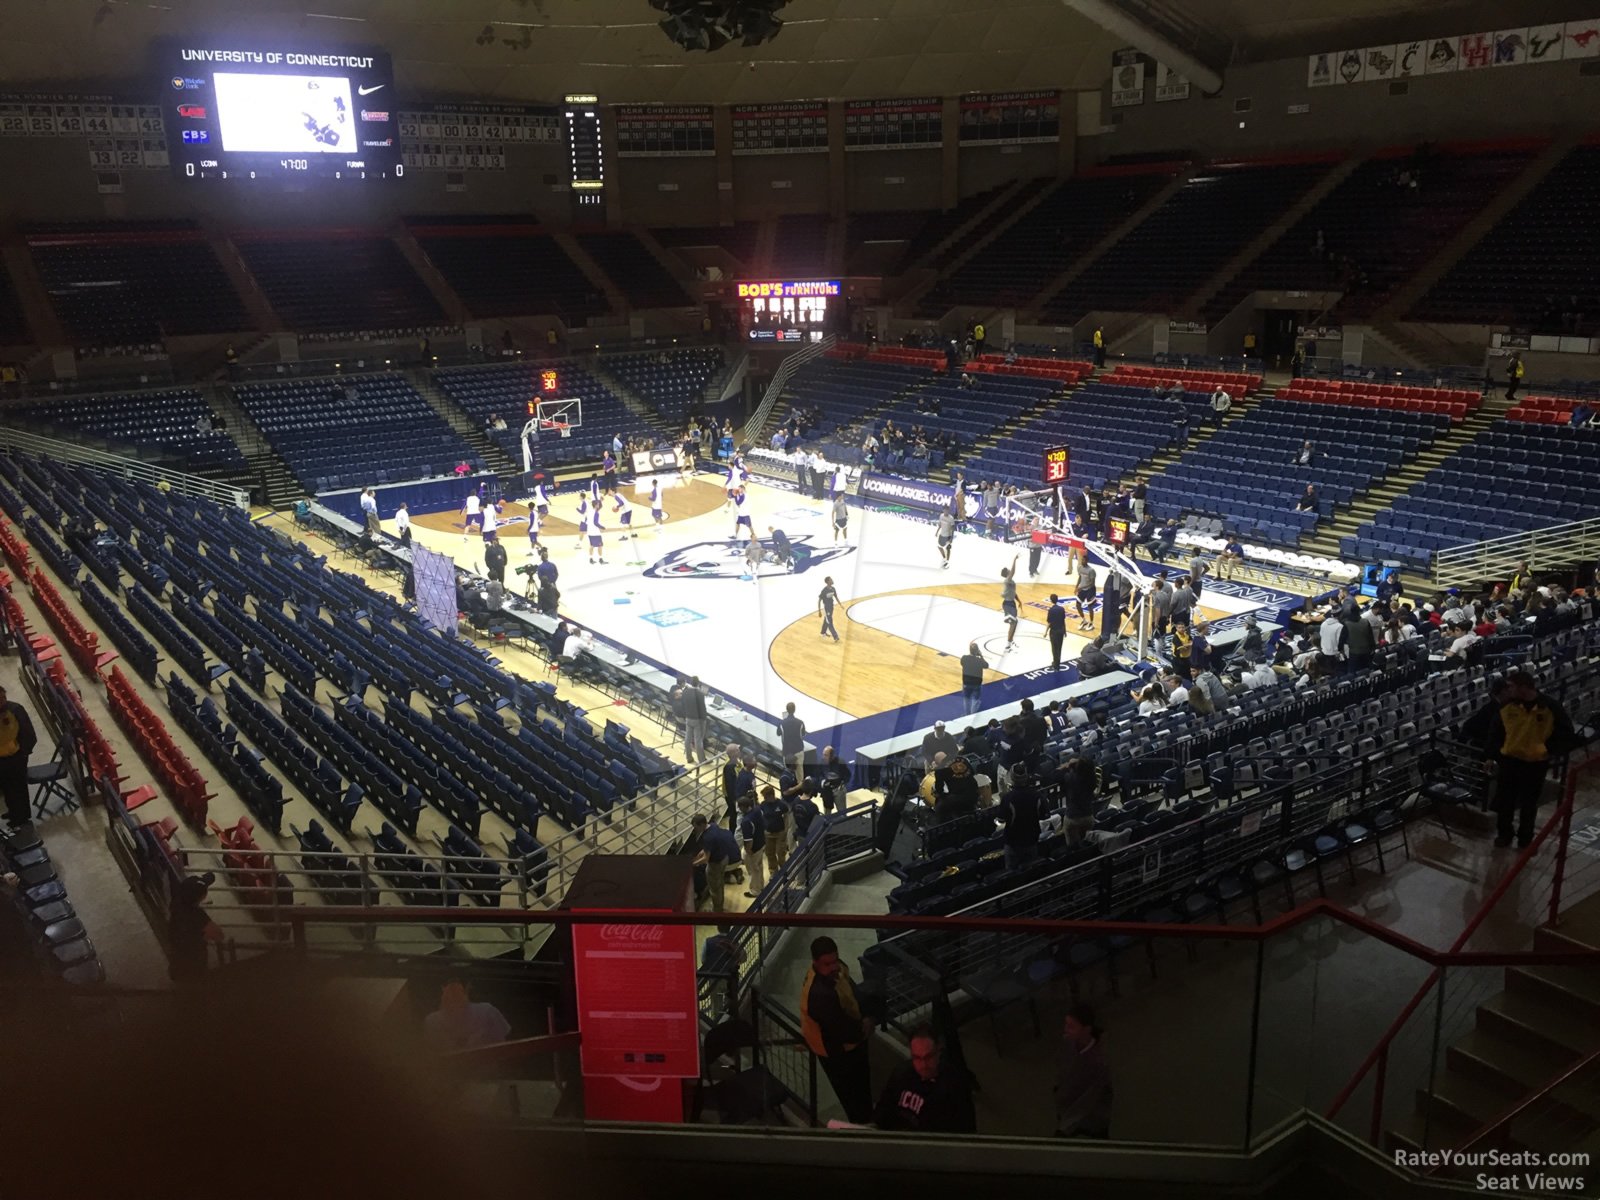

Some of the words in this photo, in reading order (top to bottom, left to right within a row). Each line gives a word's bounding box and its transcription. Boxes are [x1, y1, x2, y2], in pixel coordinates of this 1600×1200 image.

[181, 49, 263, 64] UNIVERSITY
[266, 52, 283, 64] OF
[286, 53, 374, 69] CONNECTICUT
[61, 118, 81, 130] 42
[88, 118, 107, 130] 44
[182, 130, 208, 140] CBS
[444, 126, 459, 136] 00
[466, 126, 478, 137] 13
[486, 127, 501, 138] 42
[186, 162, 195, 177] 0
[280, 159, 308, 171] 47:00
[396, 164, 404, 177] 0
[738, 282, 784, 296] BOB'S
[785, 285, 838, 296] FURNITURE
[544, 379, 556, 390] 30
[1048, 451, 1066, 462] 47:00
[1050, 462, 1064, 480] 30
[863, 479, 952, 506] UCONNHUSKIES.COM
[1114, 530, 1124, 542] 30
[1056, 716, 1066, 727] 11
